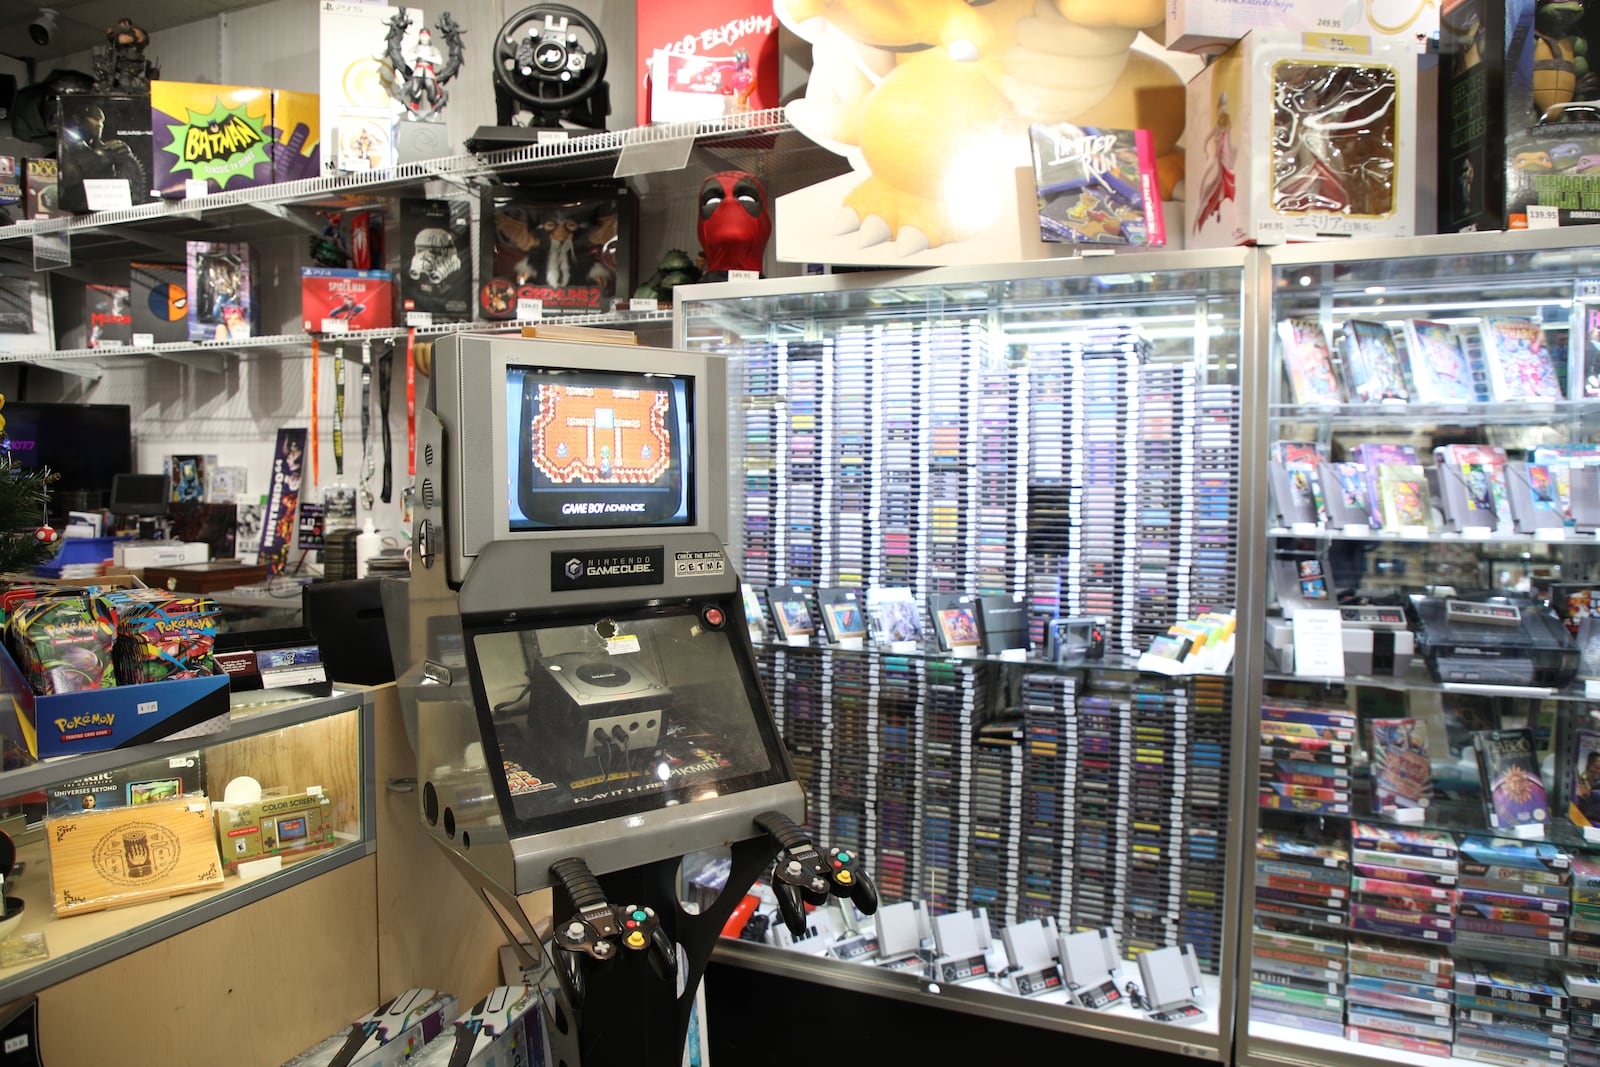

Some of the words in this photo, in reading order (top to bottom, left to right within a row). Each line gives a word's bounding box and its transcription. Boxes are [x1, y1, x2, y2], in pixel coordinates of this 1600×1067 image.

[1317, 18, 1341, 28] 249.95
[700, 15, 773, 50] ELYSIUM
[185, 115, 261, 161] BATMAN
[1535, 175, 1588, 192] TEENAGE
[1295, 214, 1343, 230] エミリア
[1530, 210, 1557, 219] 139.95
[517, 284, 588, 301] GREMLINS
[588, 286, 600, 307] 2
[263, 472, 284, 547] NINTENDO
[562, 503, 588, 515] GAME
[588, 503, 605, 513] BOY
[605, 503, 646, 512] ADVANCE
[587, 556, 650, 566] NINTENDO
[54, 711, 116, 733] Pokémon
[65, 733, 84, 741] TRADING
[96, 729, 108, 737] GAME
[669, 761, 721, 778] PIKMIN
[54, 787, 91, 797] UNIVERSES
[91, 785, 118, 794] BEYOND
[573, 792, 609, 804] PLAY
[612, 788, 624, 796] IT
[262, 802, 289, 812] COLOR
[289, 797, 317, 807] SCREEN
